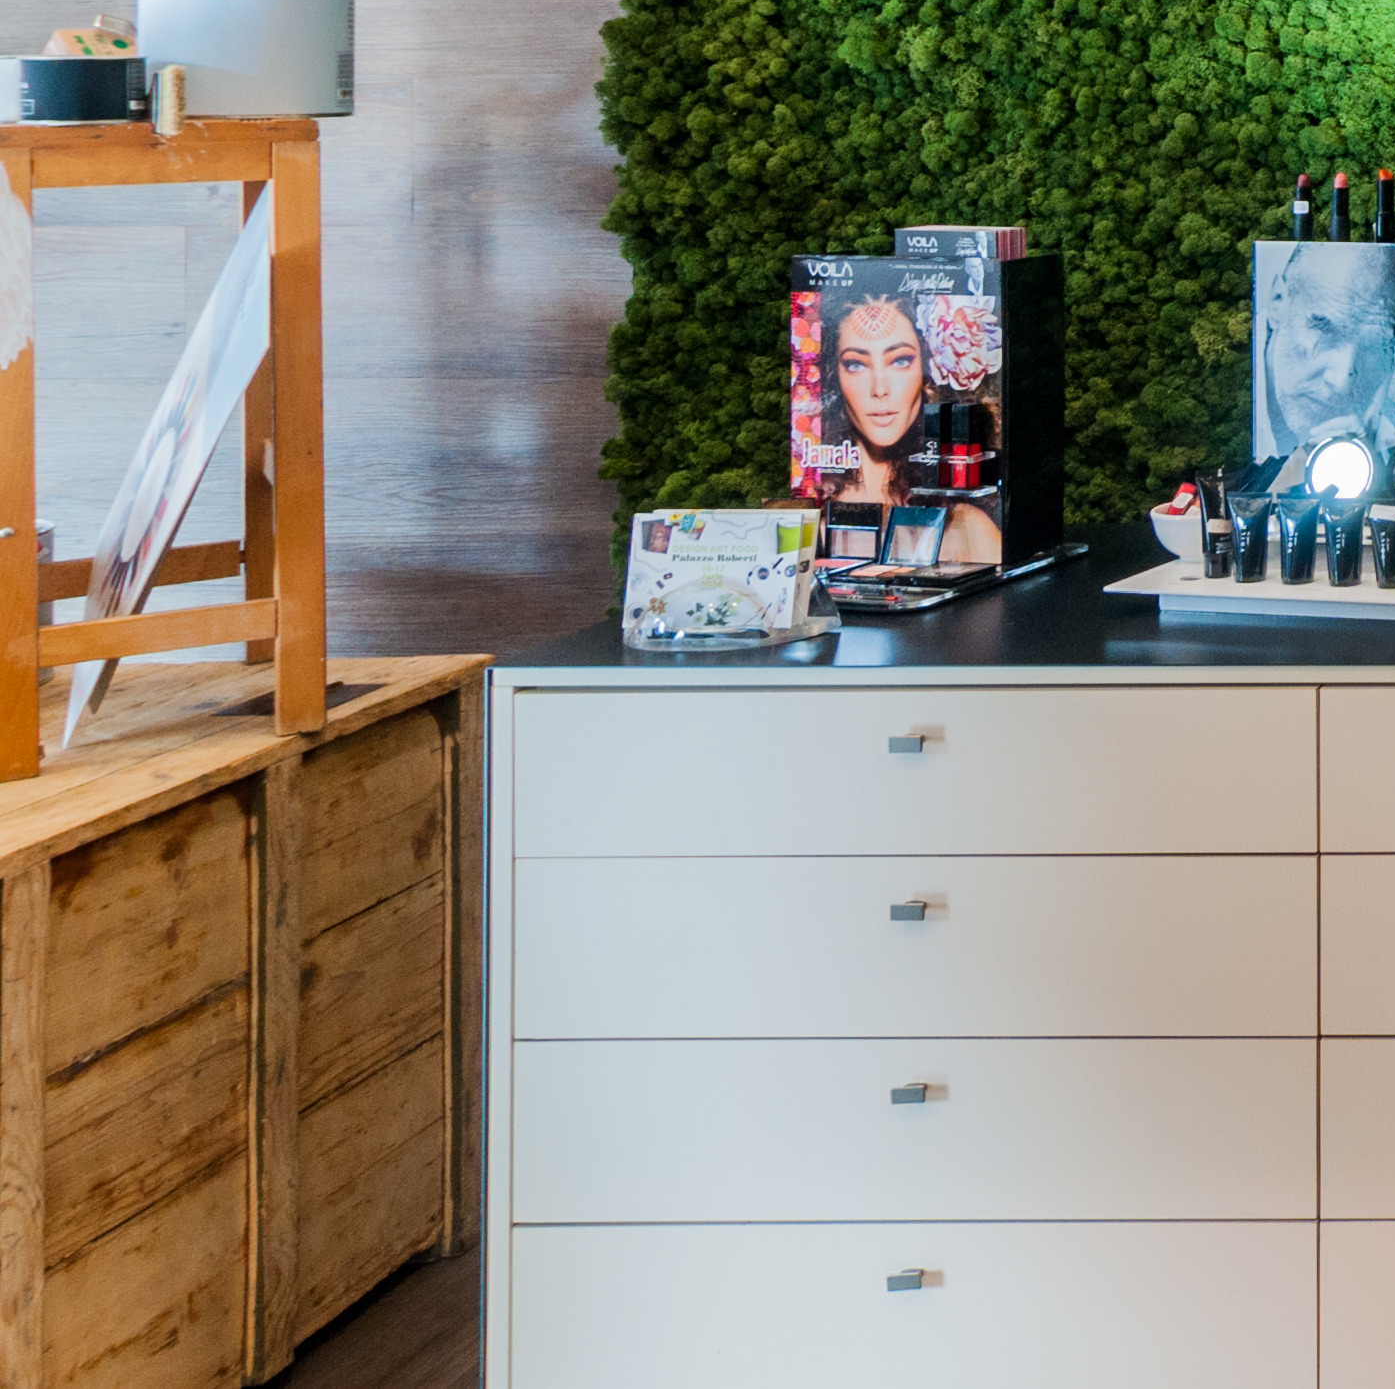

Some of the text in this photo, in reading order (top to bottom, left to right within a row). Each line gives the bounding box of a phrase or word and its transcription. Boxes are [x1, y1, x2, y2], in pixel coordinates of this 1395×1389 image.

[800, 437, 861, 469] Jamala
[672, 544, 758, 553] DESIGN ART FOOD
[672, 554, 714, 562] Palazzo
